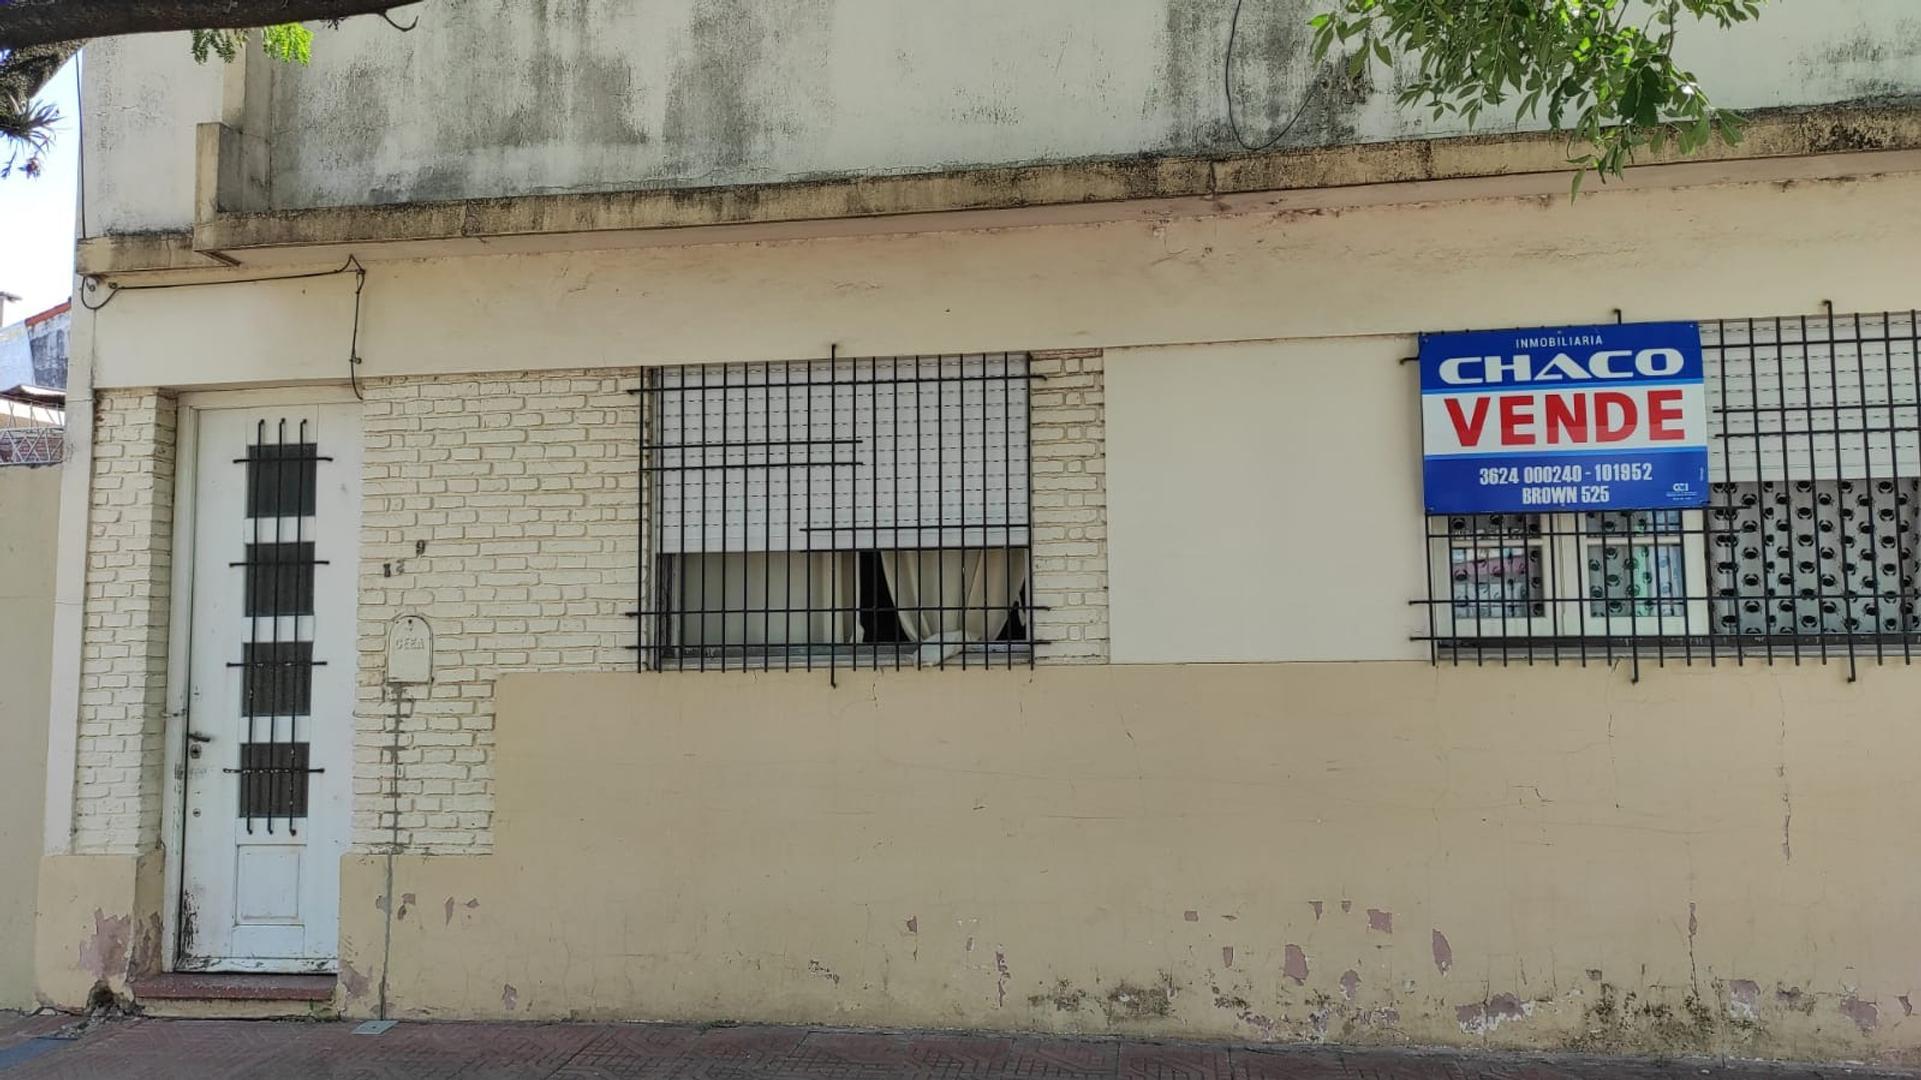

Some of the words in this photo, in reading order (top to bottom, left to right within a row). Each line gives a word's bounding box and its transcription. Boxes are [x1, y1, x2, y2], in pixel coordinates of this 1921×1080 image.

[1515, 335, 1603, 349] INMOBILIARIA
[1439, 347, 1685, 385] CHACO
[1444, 389, 1685, 447] VENDE
[1479, 467, 1519, 485] 3624
[1524, 465, 1583, 484] 000240
[1595, 463, 1652, 482] 101952
[1521, 487, 1577, 505] BROWN
[1581, 486, 1610, 503] 525
